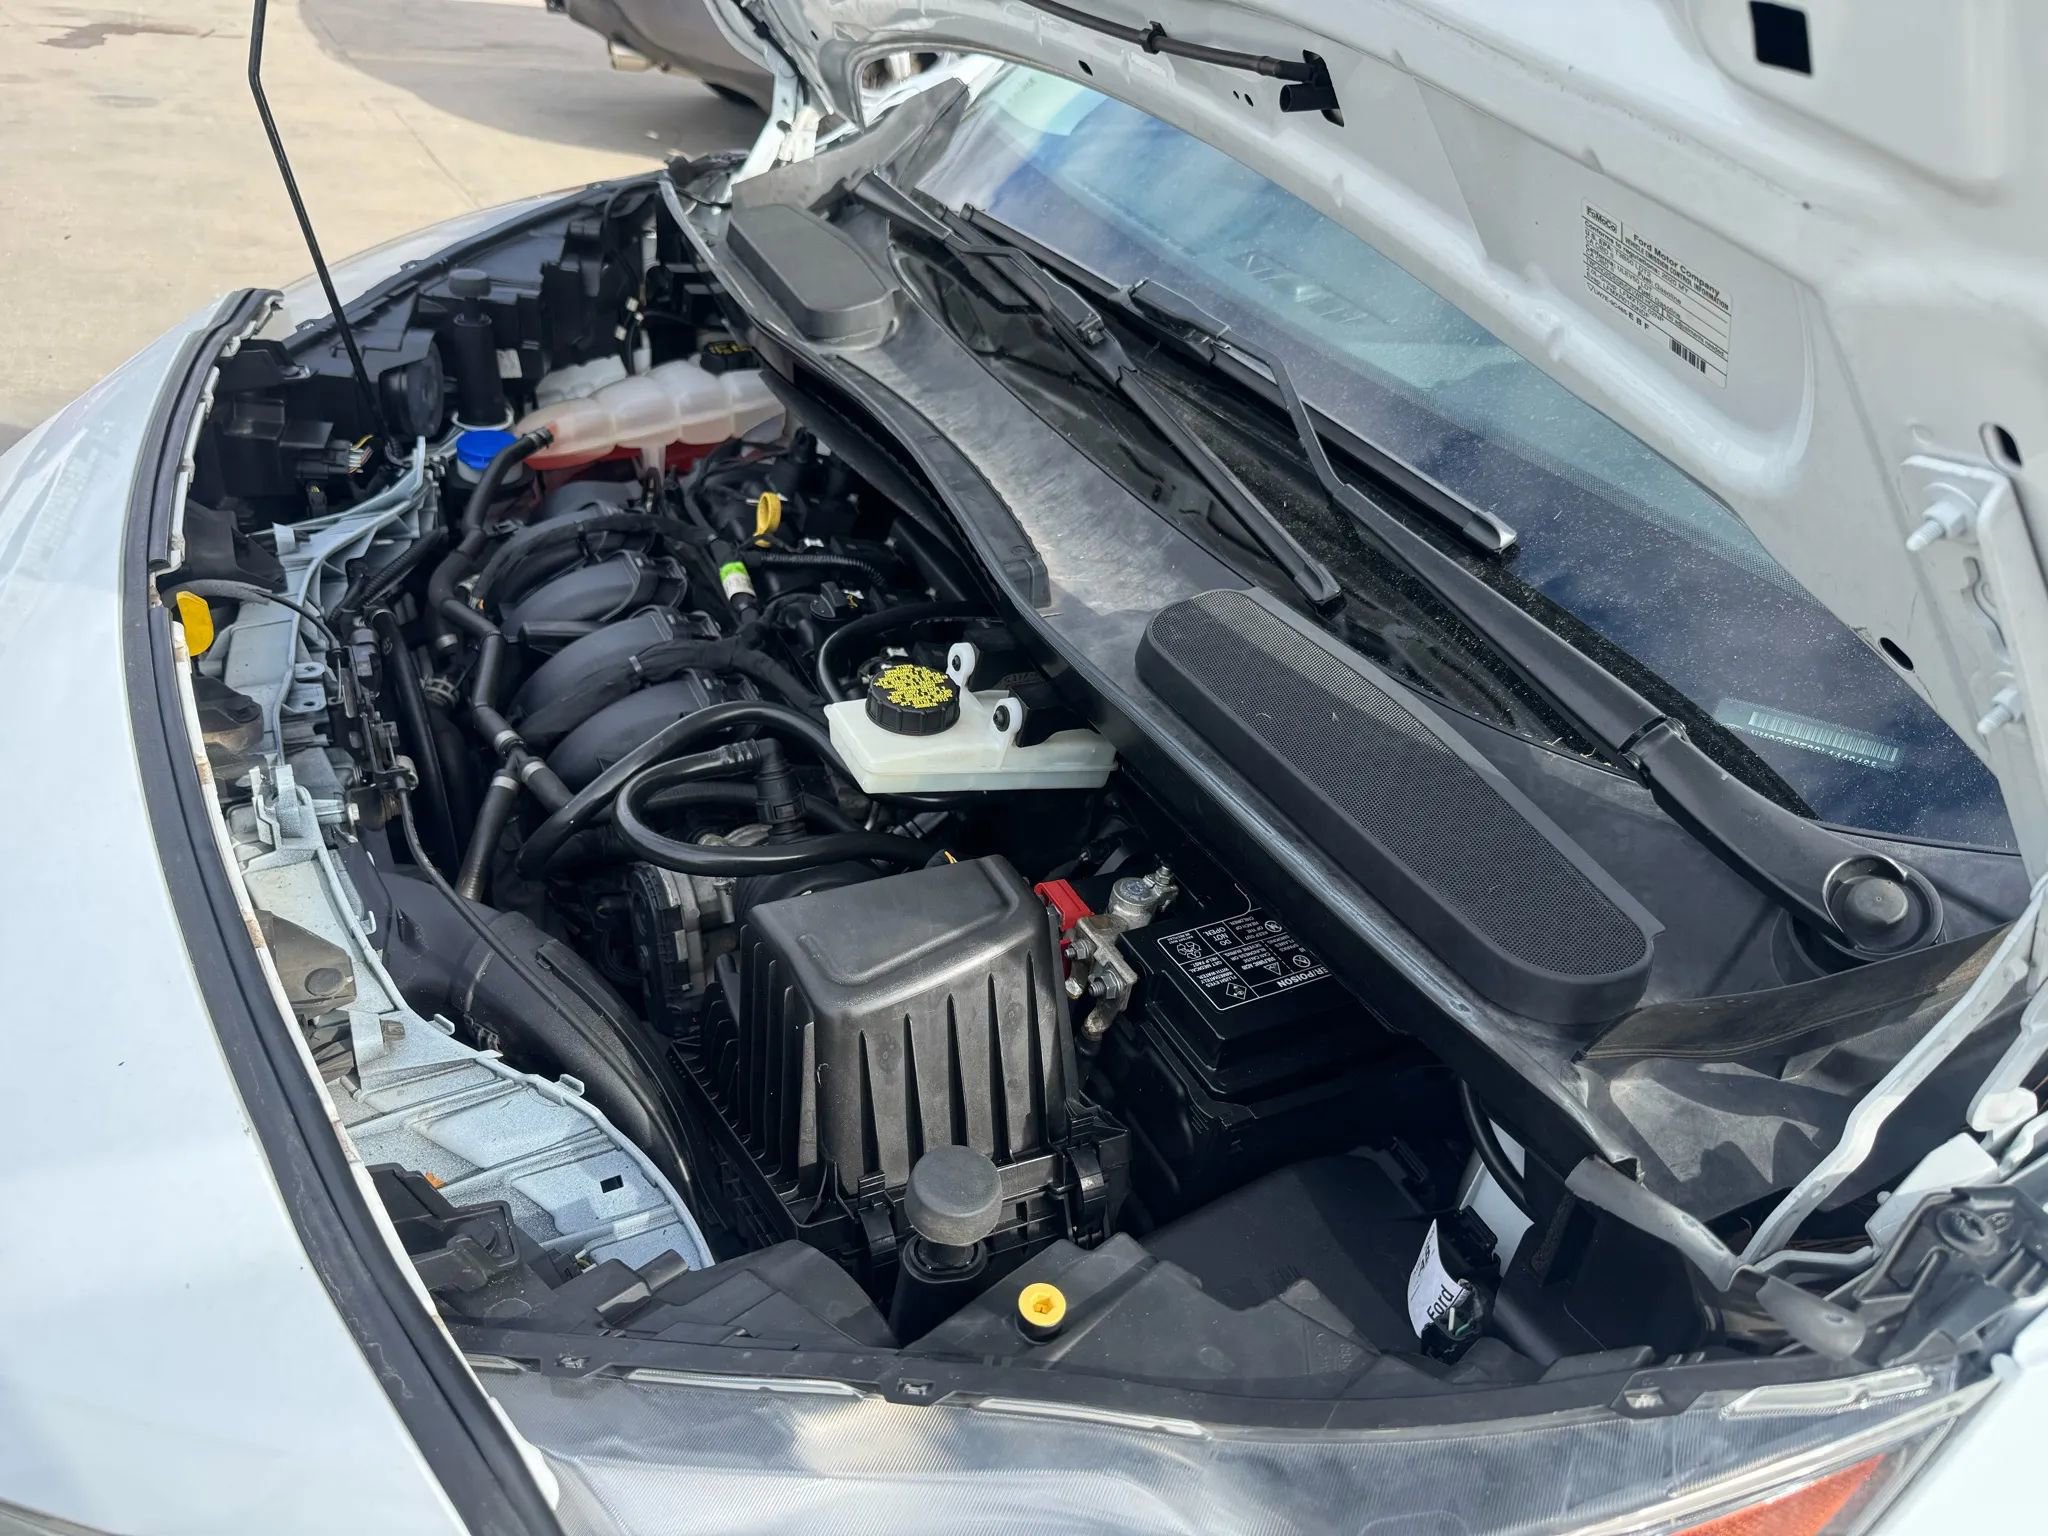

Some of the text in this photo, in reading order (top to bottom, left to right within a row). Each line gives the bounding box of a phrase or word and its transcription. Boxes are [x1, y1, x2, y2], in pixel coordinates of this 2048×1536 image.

[1584, 219, 1613, 244] Conforms
[1615, 240, 1621, 249] to
[1661, 271, 1676, 286] 2020
[1678, 282, 1688, 294] MY
[1625, 237, 1728, 311] VEHICLE EMISSION CONTROL INFORMATION
[1633, 233, 1719, 297] Ford Motor Company
[1210, 932, 1229, 941] NOT
[1217, 938, 1232, 946] DO
[1427, 1283, 1455, 1321] Ford
